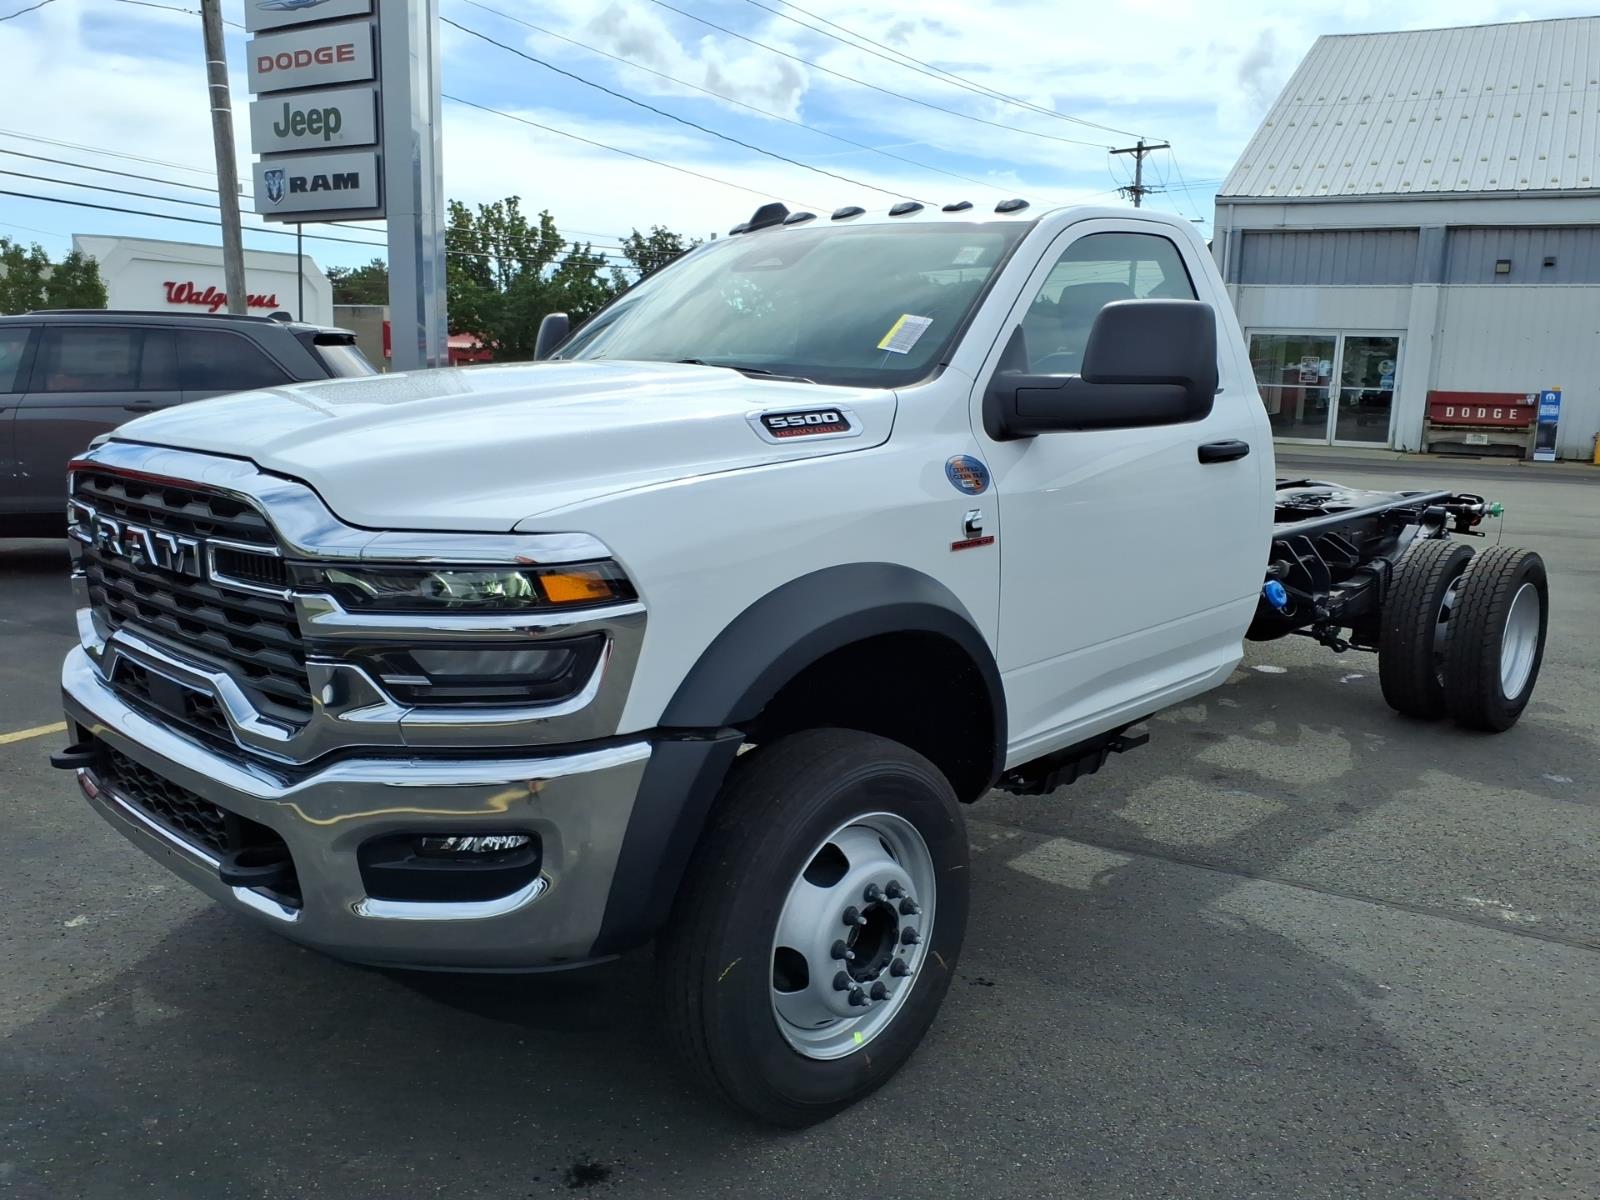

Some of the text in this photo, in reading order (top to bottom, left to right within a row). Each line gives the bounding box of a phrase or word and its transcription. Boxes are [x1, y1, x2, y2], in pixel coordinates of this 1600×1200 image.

[257, 43, 355, 74] DODGE
[273, 102, 342, 142] Jeep
[289, 172, 360, 194] RAM
[163, 281, 280, 313] Walgens
[768, 412, 839, 429] 5500
[1445, 406, 1518, 420] DODGE
[97, 516, 201, 578] RAM
